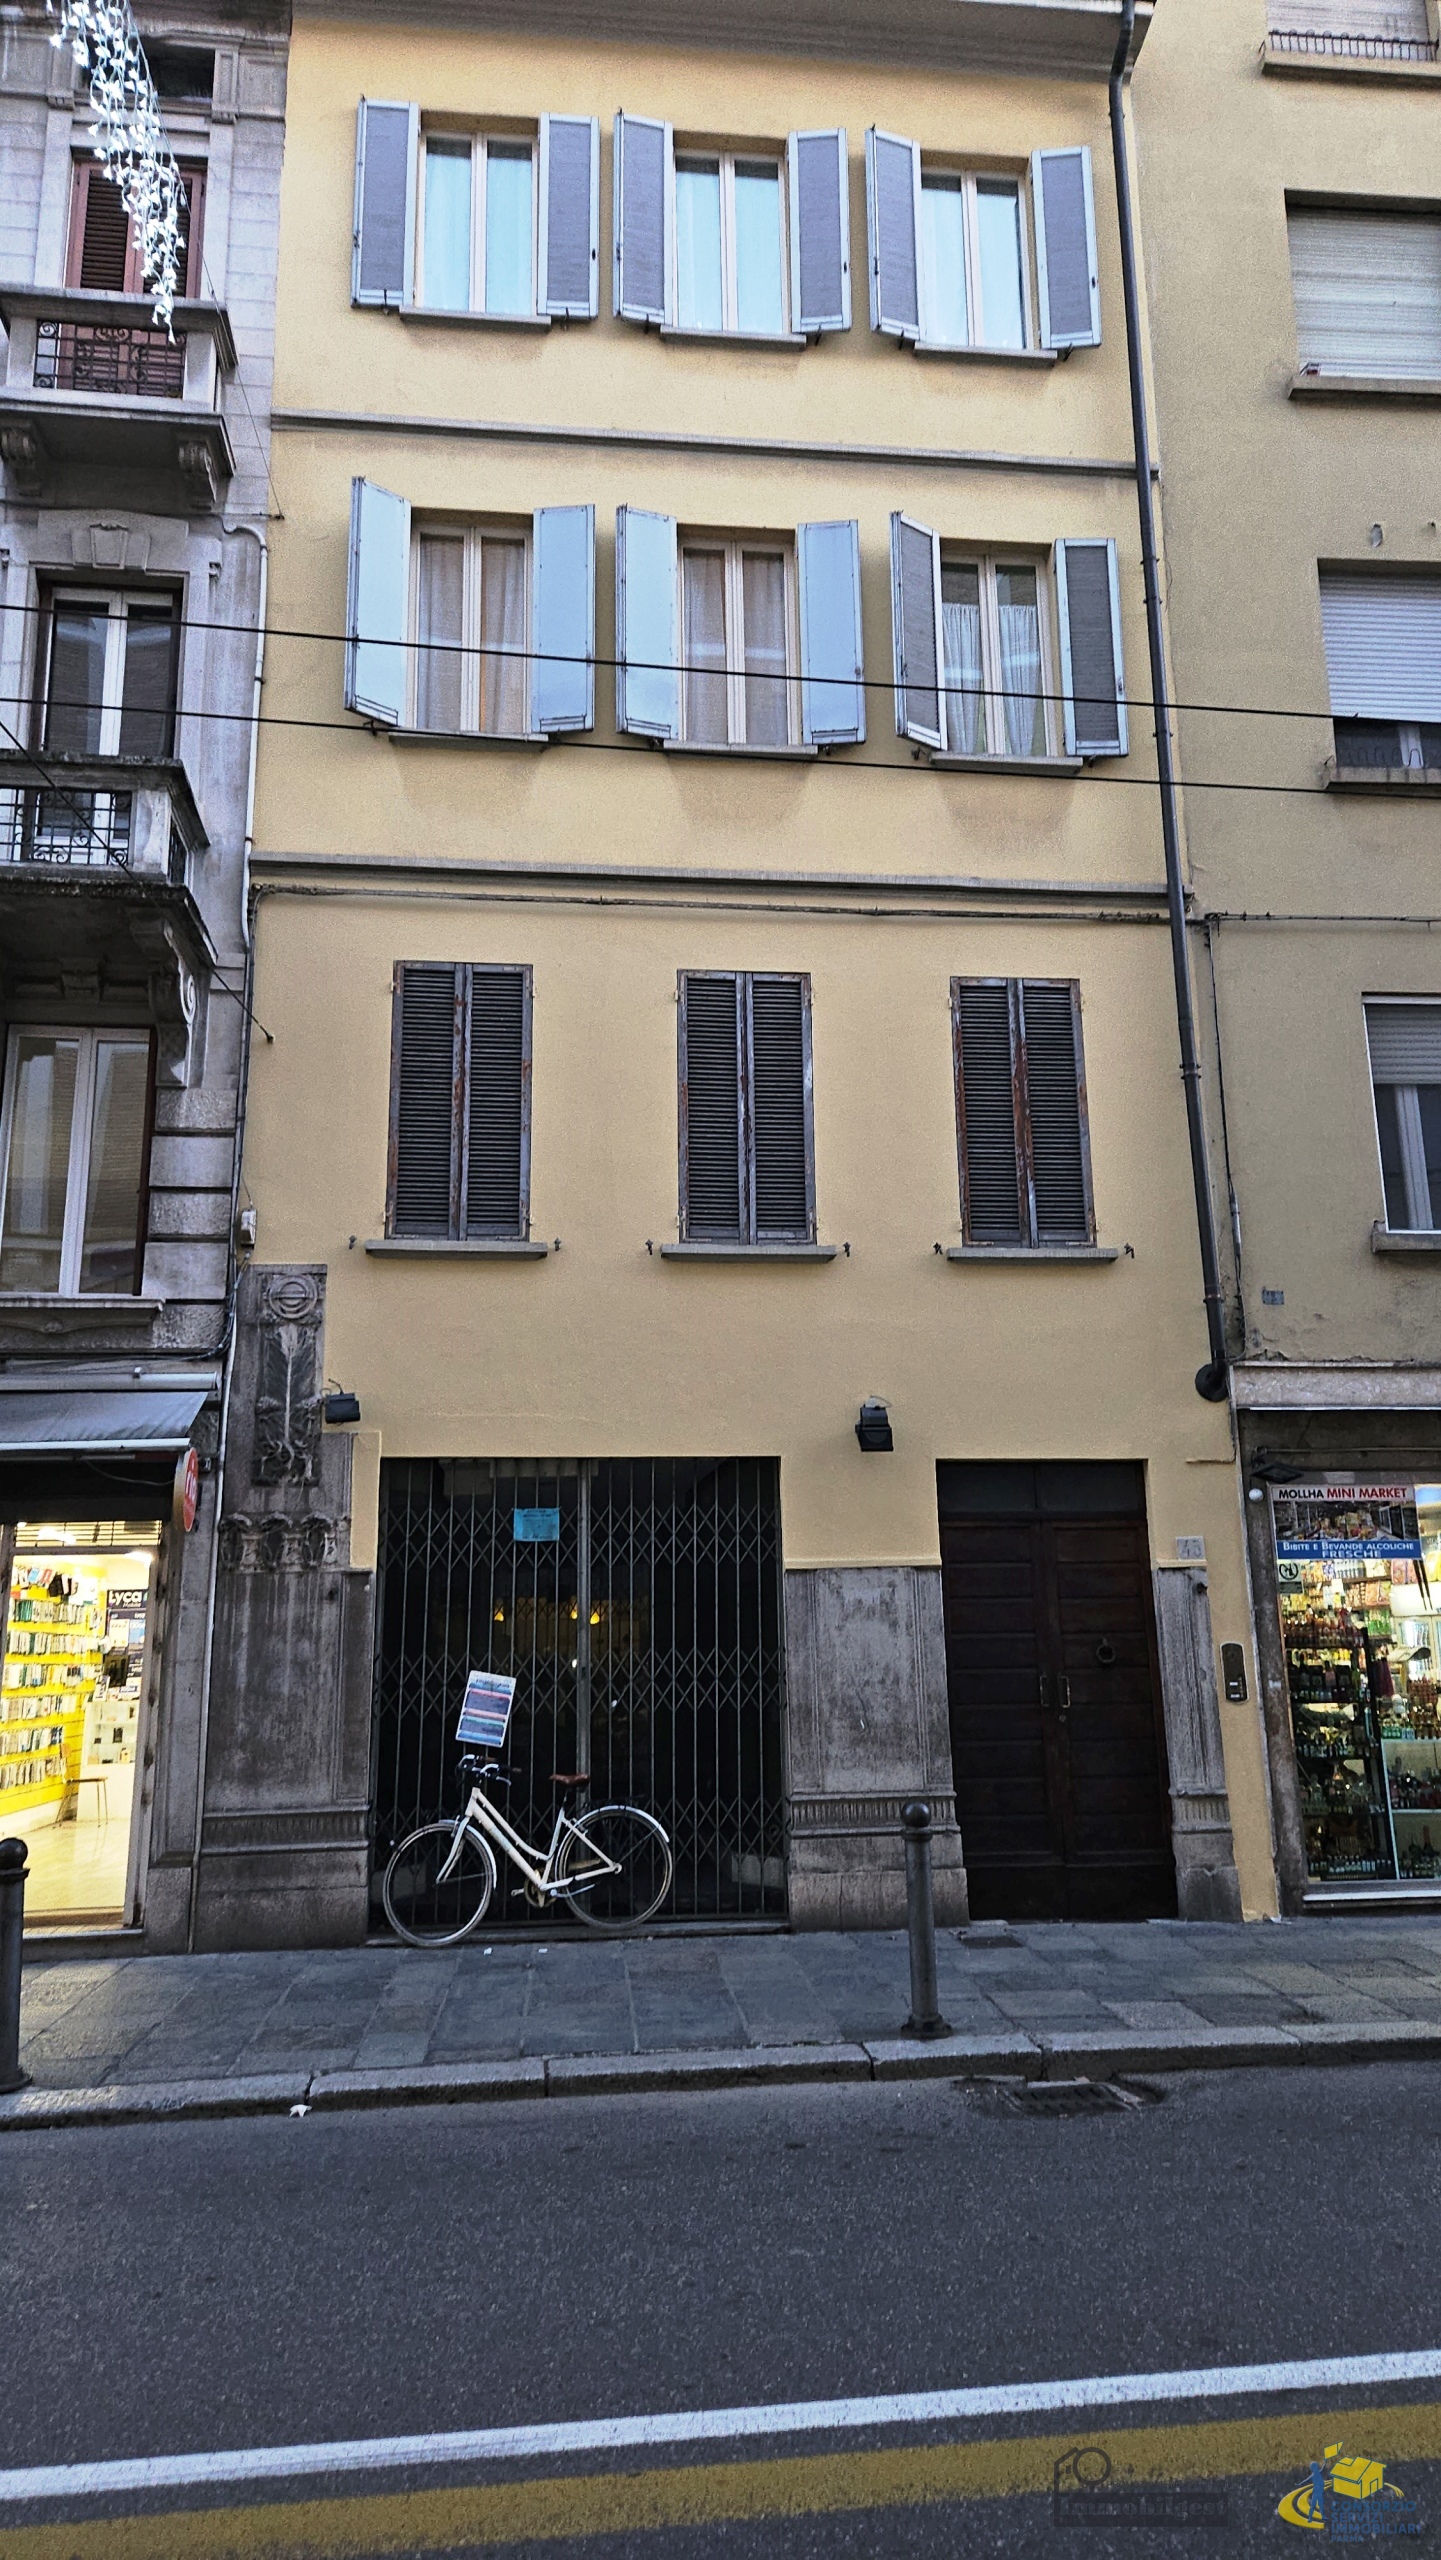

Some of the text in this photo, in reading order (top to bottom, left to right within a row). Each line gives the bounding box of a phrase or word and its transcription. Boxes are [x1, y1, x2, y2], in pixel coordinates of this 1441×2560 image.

[1279, 1487, 1407, 1499] MOLLHA MINI MARKET
[1366, 1542, 1414, 1551] ALCOLICHE
[1322, 1550, 1382, 1559] FRESCHE
[108, 1590, 142, 1606] Lyca
